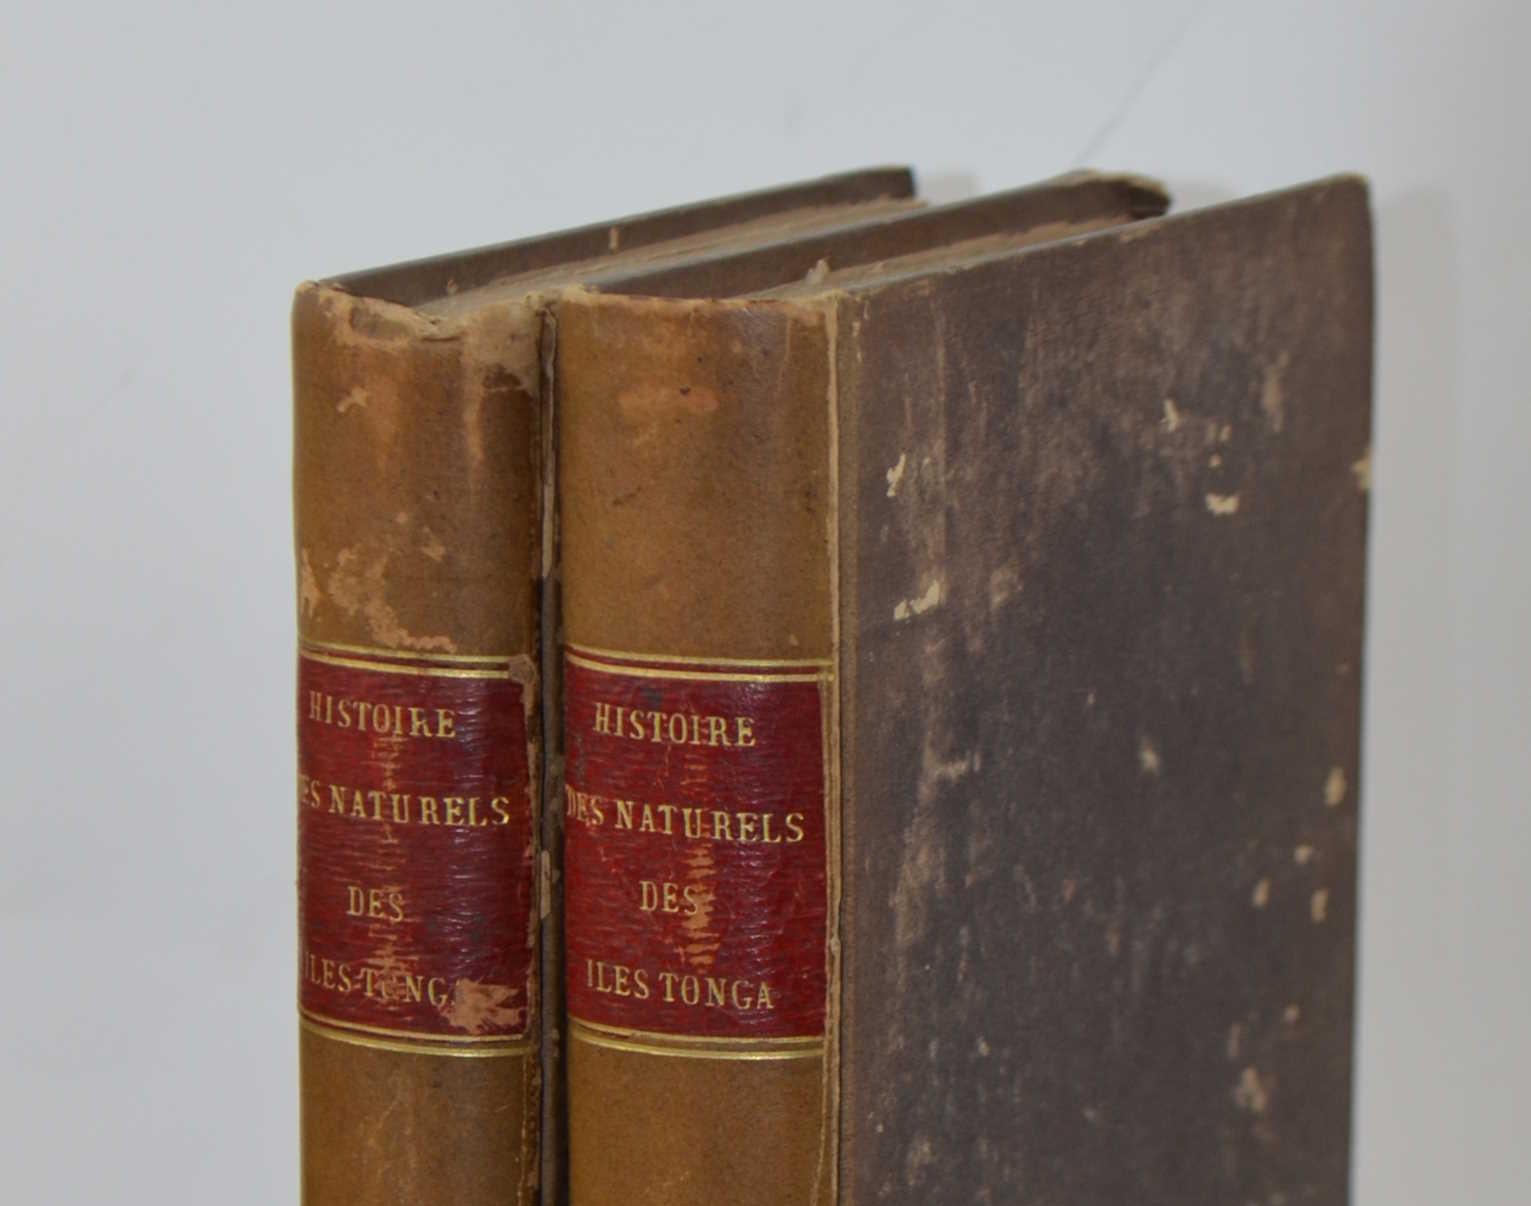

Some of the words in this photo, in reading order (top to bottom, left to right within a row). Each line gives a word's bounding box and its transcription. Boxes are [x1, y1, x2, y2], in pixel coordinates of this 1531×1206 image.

[309, 689, 457, 739] HISTOIRE
[592, 702, 757, 748] HISTOIRE
[328, 783, 510, 827] NATURELS
[565, 784, 604, 825] DES
[614, 799, 805, 843] NATURELS
[346, 885, 405, 922] DES
[639, 880, 700, 915] DES
[360, 966, 457, 1008] TONG
[587, 959, 650, 999] ILES
[658, 971, 775, 1010] TONGA
